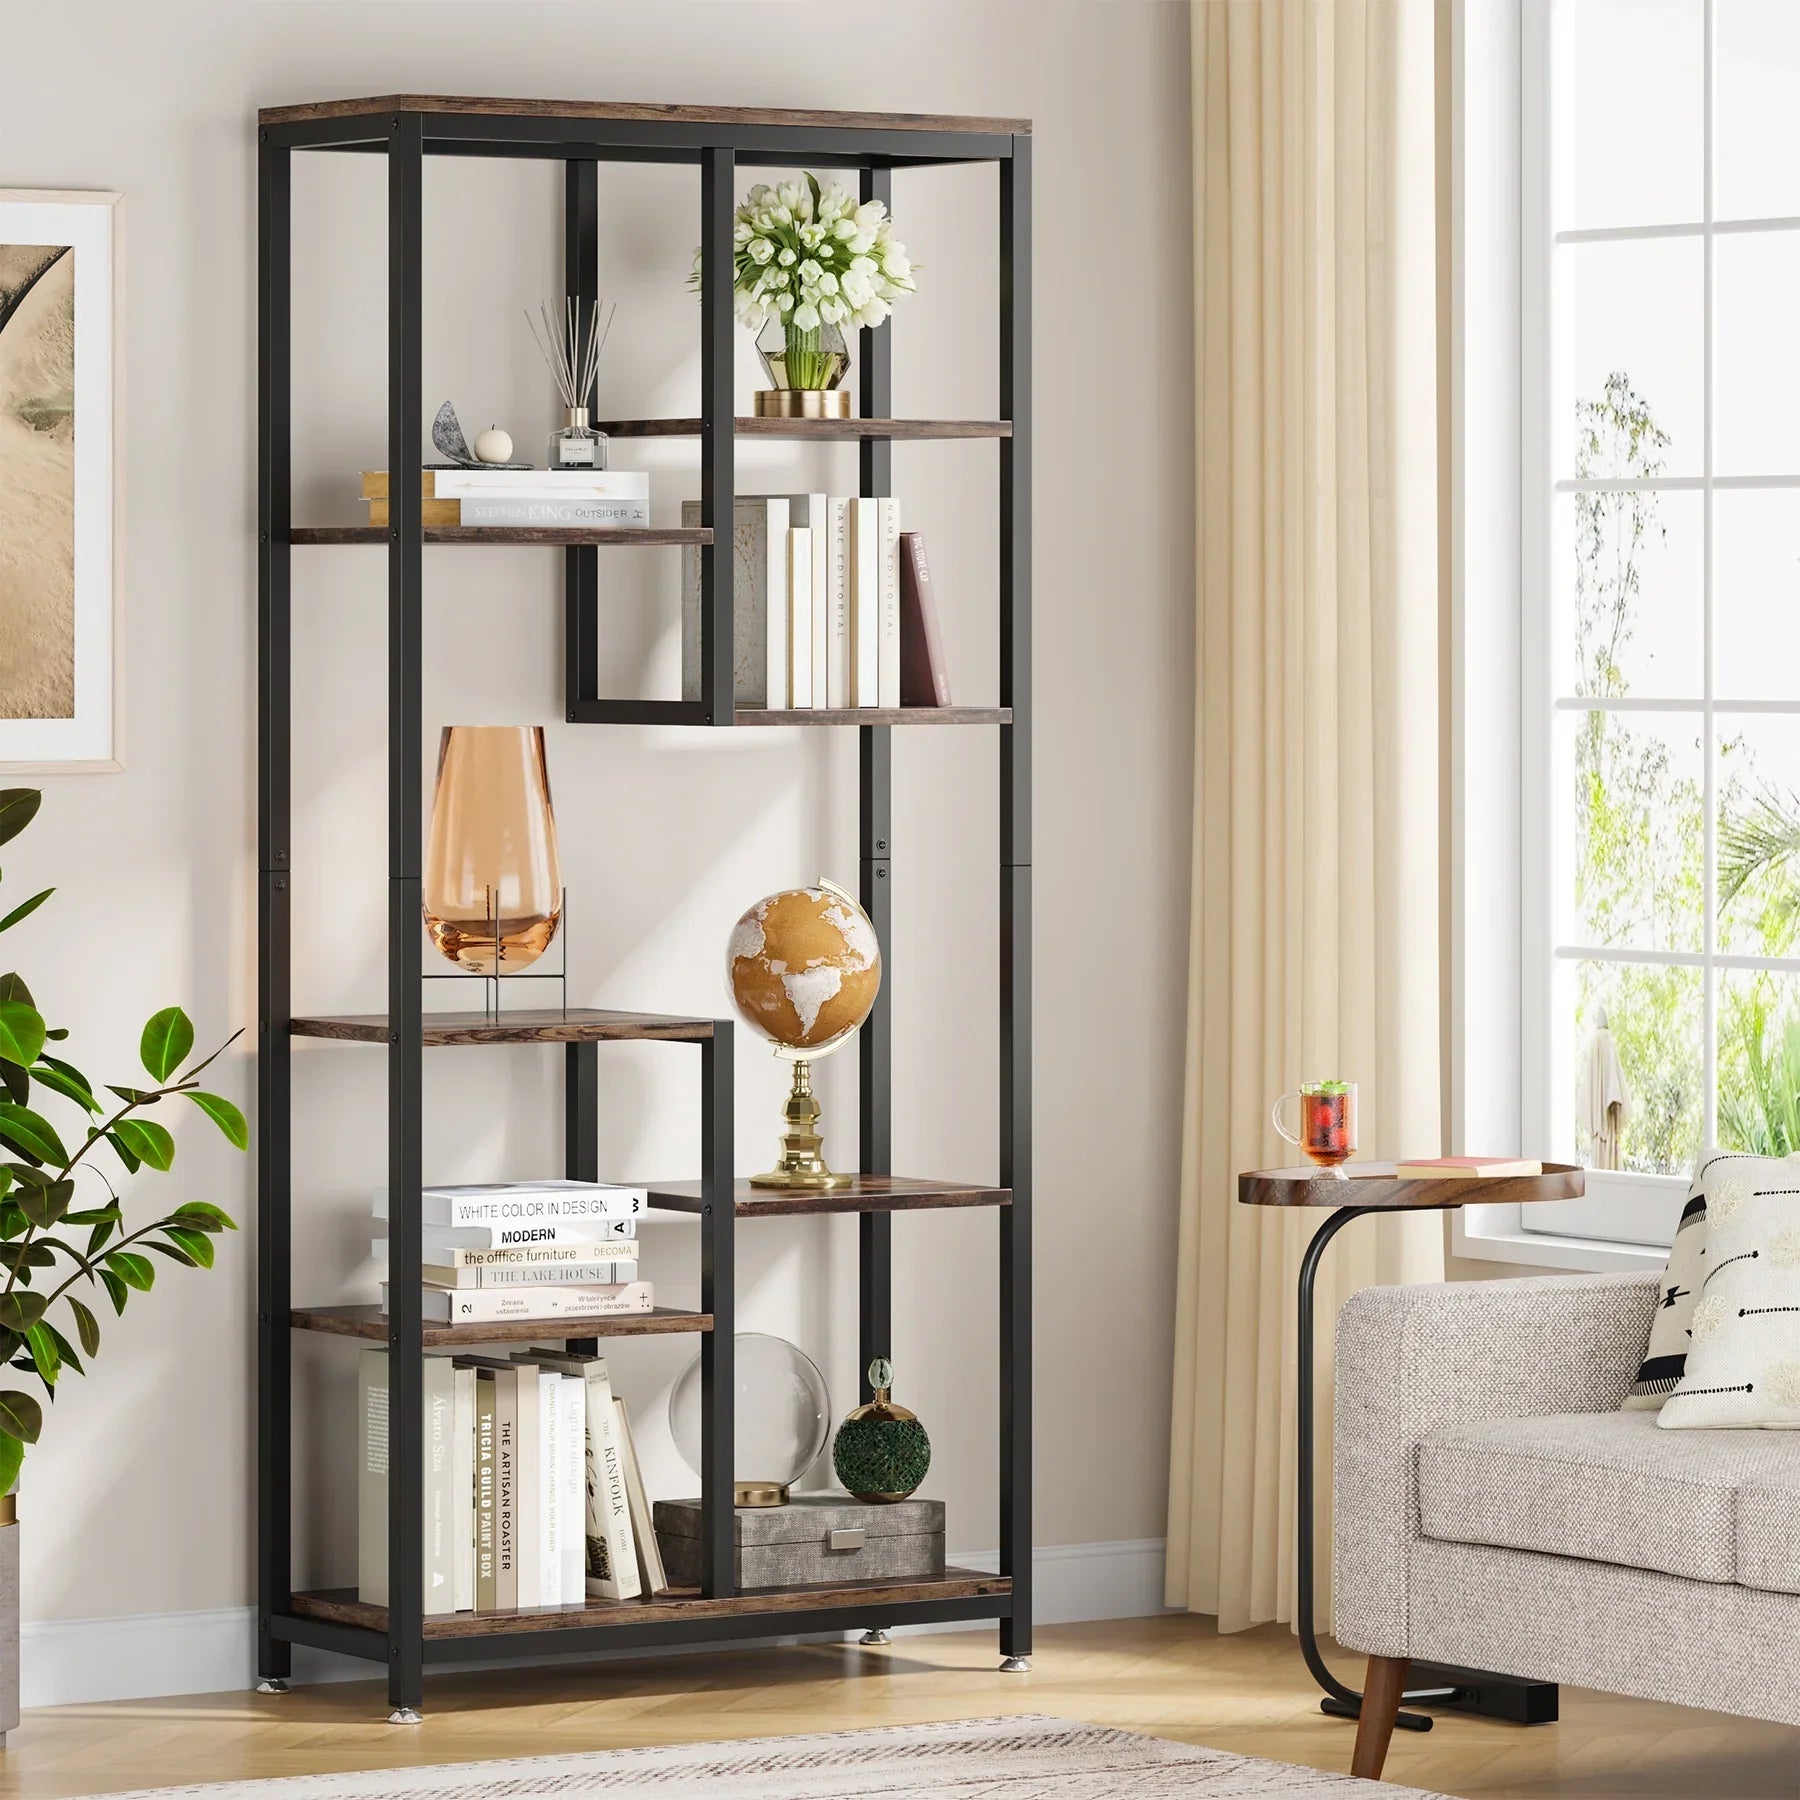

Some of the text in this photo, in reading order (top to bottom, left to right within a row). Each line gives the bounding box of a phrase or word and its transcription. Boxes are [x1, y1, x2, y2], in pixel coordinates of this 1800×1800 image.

[474, 506, 523, 518] STEPHEN
[527, 505, 571, 521] KING
[575, 508, 628, 519] OUTSIDER
[915, 549, 927, 569] STONE
[459, 1200, 608, 1219] WHITE COLOR IN DESIGN
[632, 1198, 640, 1213] W
[613, 1221, 625, 1233] A
[501, 1228, 556, 1243] MODERN
[465, 1252, 483, 1265] the
[526, 1248, 577, 1261] furniture
[594, 1246, 632, 1257] DECOMA
[490, 1267, 605, 1283] THE LAKE HOUSE
[461, 1303, 472, 1313] 2
[501, 1299, 524, 1307] Zmiana
[432, 1444, 445, 1472] Siza
[604, 1446, 625, 1516] KINFOLK
[481, 1413, 492, 1579] TRICIA GUILD PAINT BOX
[502, 1422, 511, 1570] THE ARTISAN ROASTER
[619, 1529, 628, 1553] HOME
